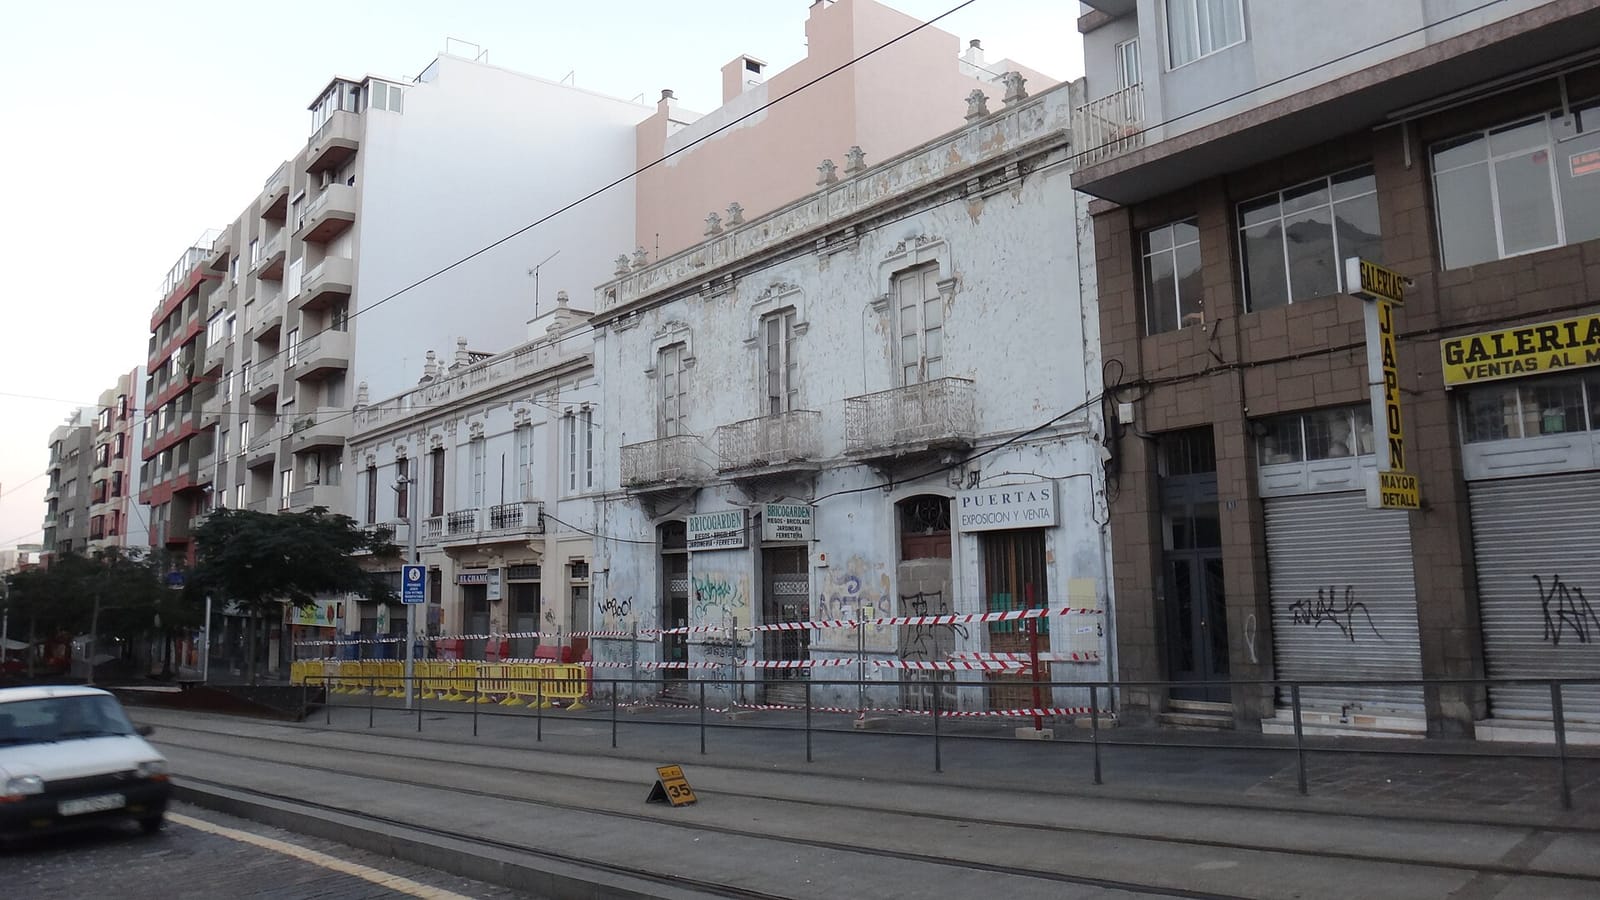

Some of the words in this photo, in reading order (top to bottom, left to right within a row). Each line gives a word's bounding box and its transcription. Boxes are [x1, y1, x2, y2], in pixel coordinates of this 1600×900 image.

[1360, 261, 1403, 302] GALERIAS
[1444, 318, 1600, 366] GALERIA
[1463, 357, 1538, 380] VENTAS
[1549, 352, 1576, 369] AL
[1380, 304, 1404, 469] JAPON
[1381, 475, 1416, 490] MAYOR
[962, 488, 1050, 508] PUERTAS
[1382, 492, 1417, 507] DETALL
[767, 505, 811, 518] BRICOGARDEN
[962, 511, 1010, 526] EXPOSICION
[1013, 510, 1020, 521] Y
[1022, 508, 1050, 521] VENTA
[690, 512, 741, 532] BRICOGARDEN
[668, 783, 691, 798] 35
